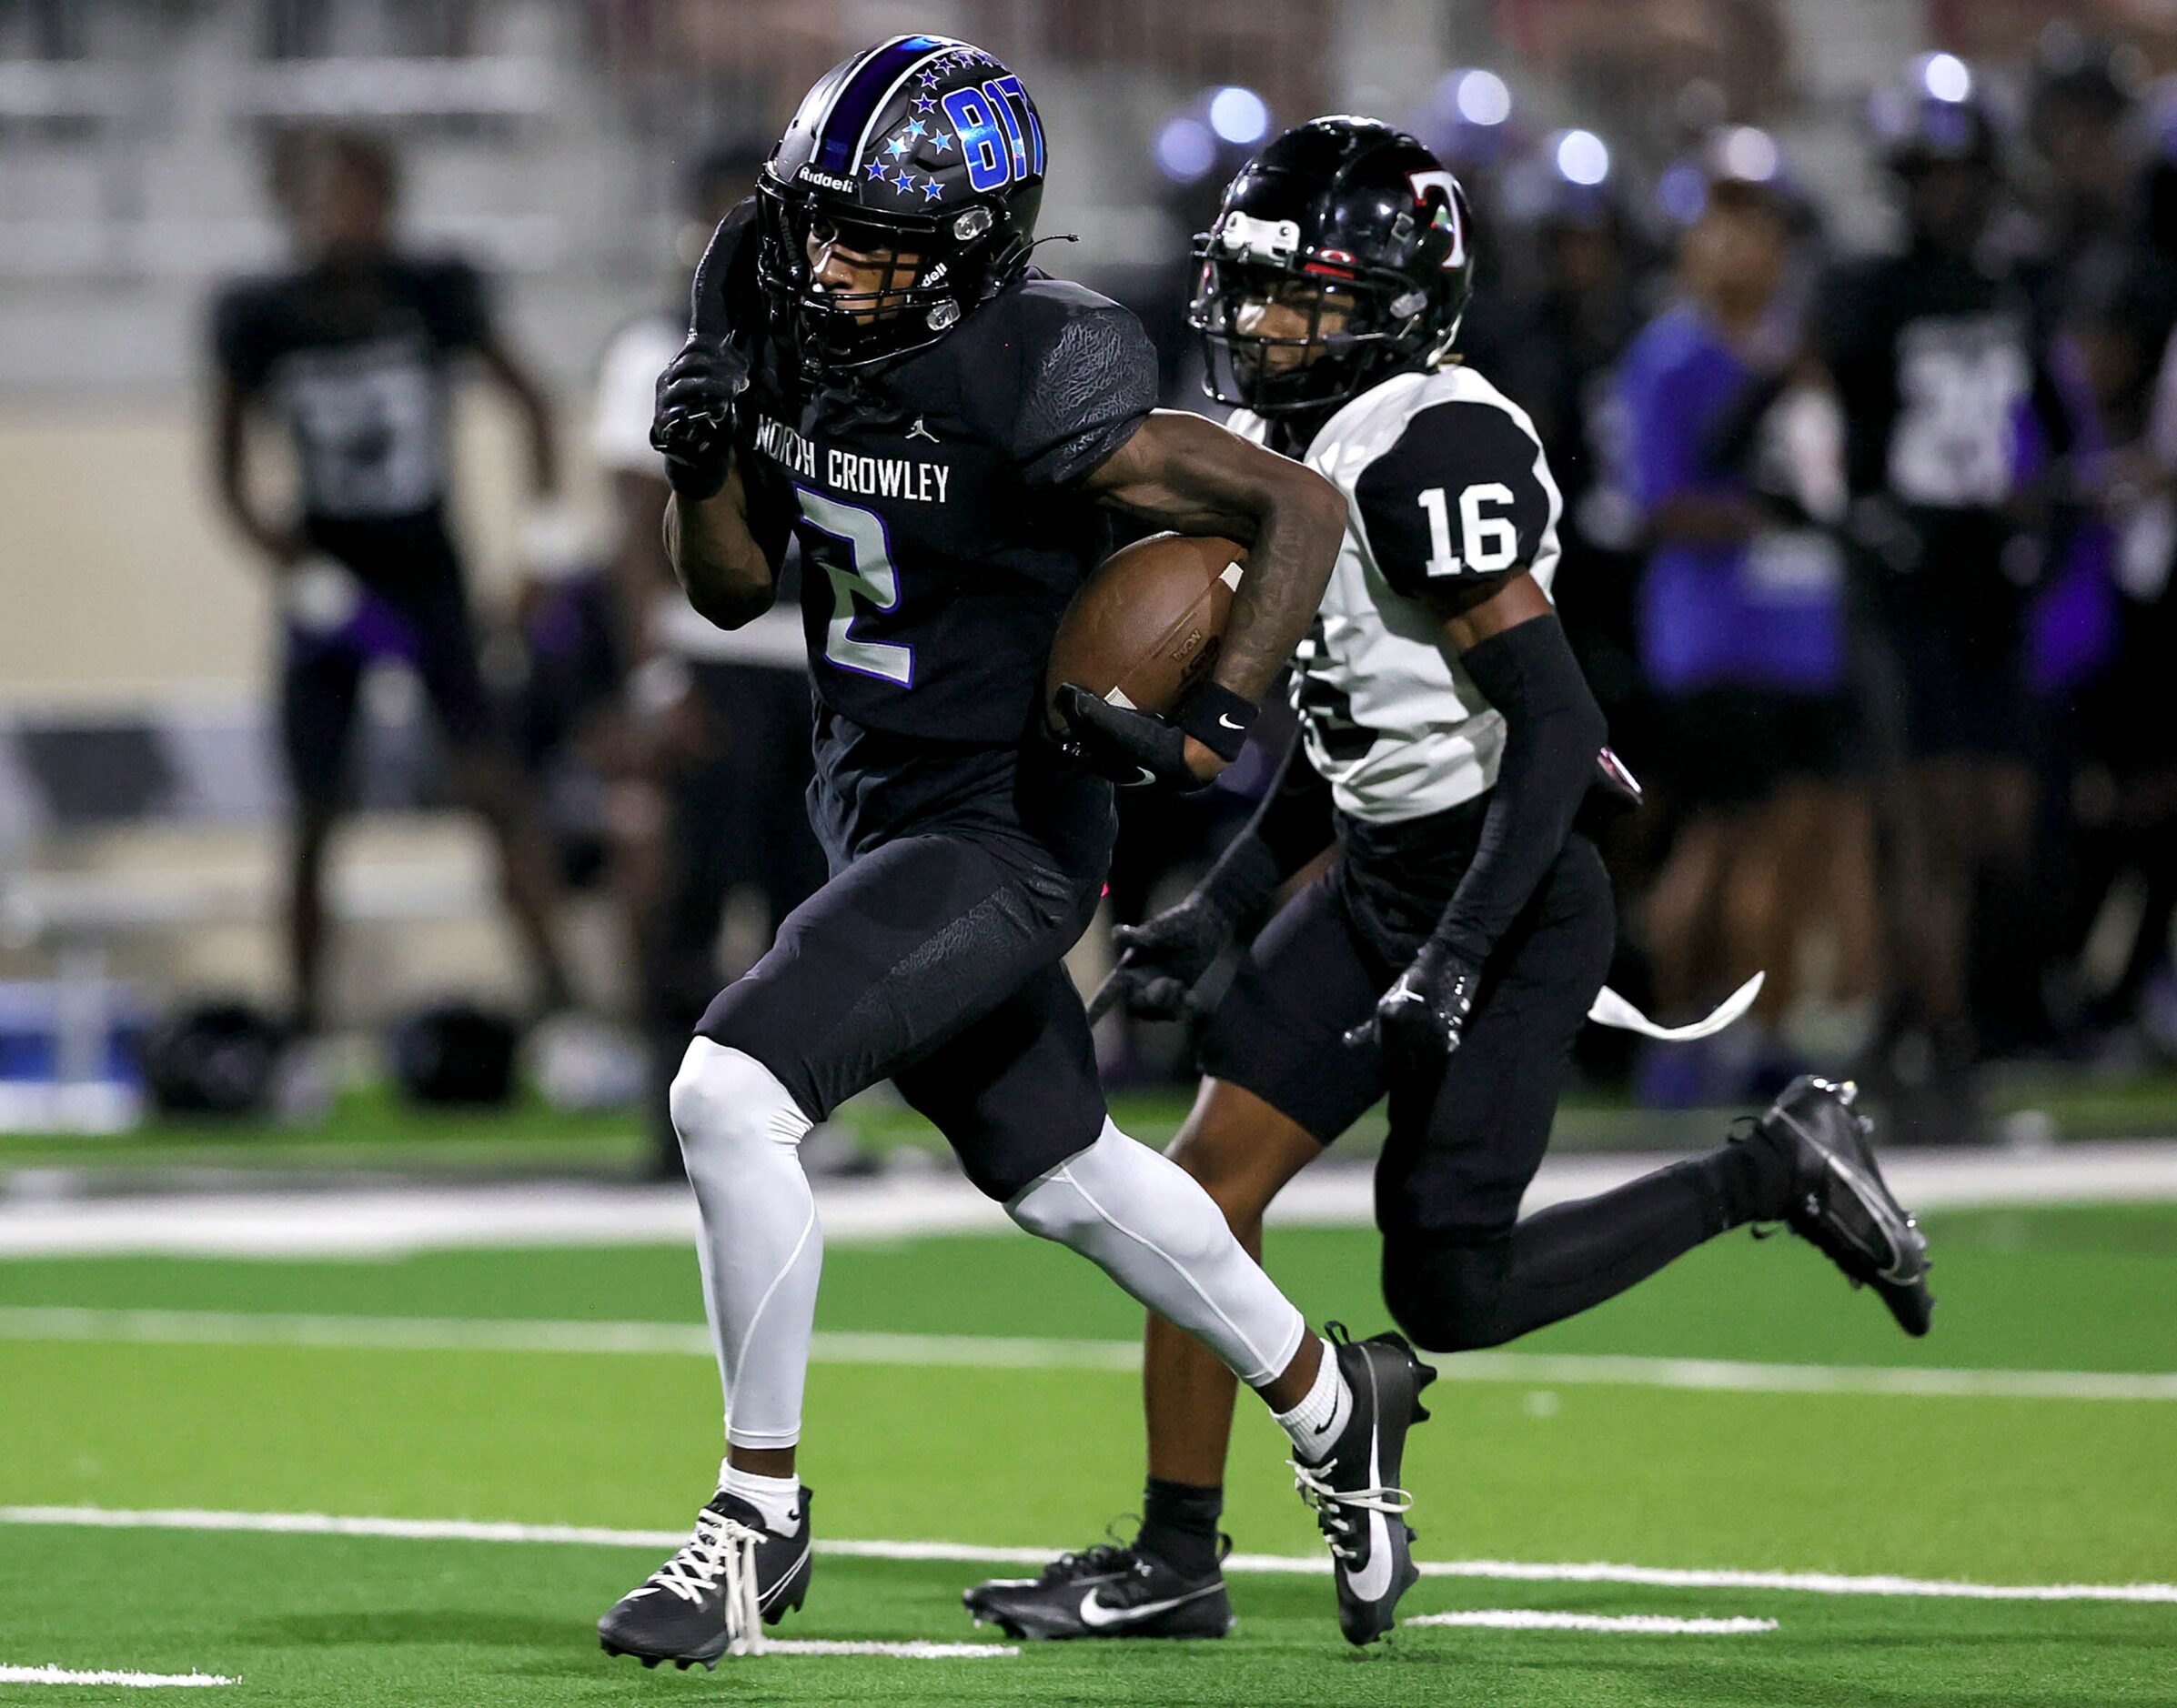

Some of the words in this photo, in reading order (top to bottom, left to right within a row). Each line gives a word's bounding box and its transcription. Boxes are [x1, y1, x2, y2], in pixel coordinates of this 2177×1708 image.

[798, 167, 854, 195] Riddell
[942, 75, 1043, 192] 817
[1406, 167, 1468, 270] T
[921, 261, 948, 287] dell
[753, 413, 816, 478] NORTH
[827, 449, 950, 504] CROWLEY
[1417, 481, 1518, 577] 16
[791, 481, 915, 689] 2
